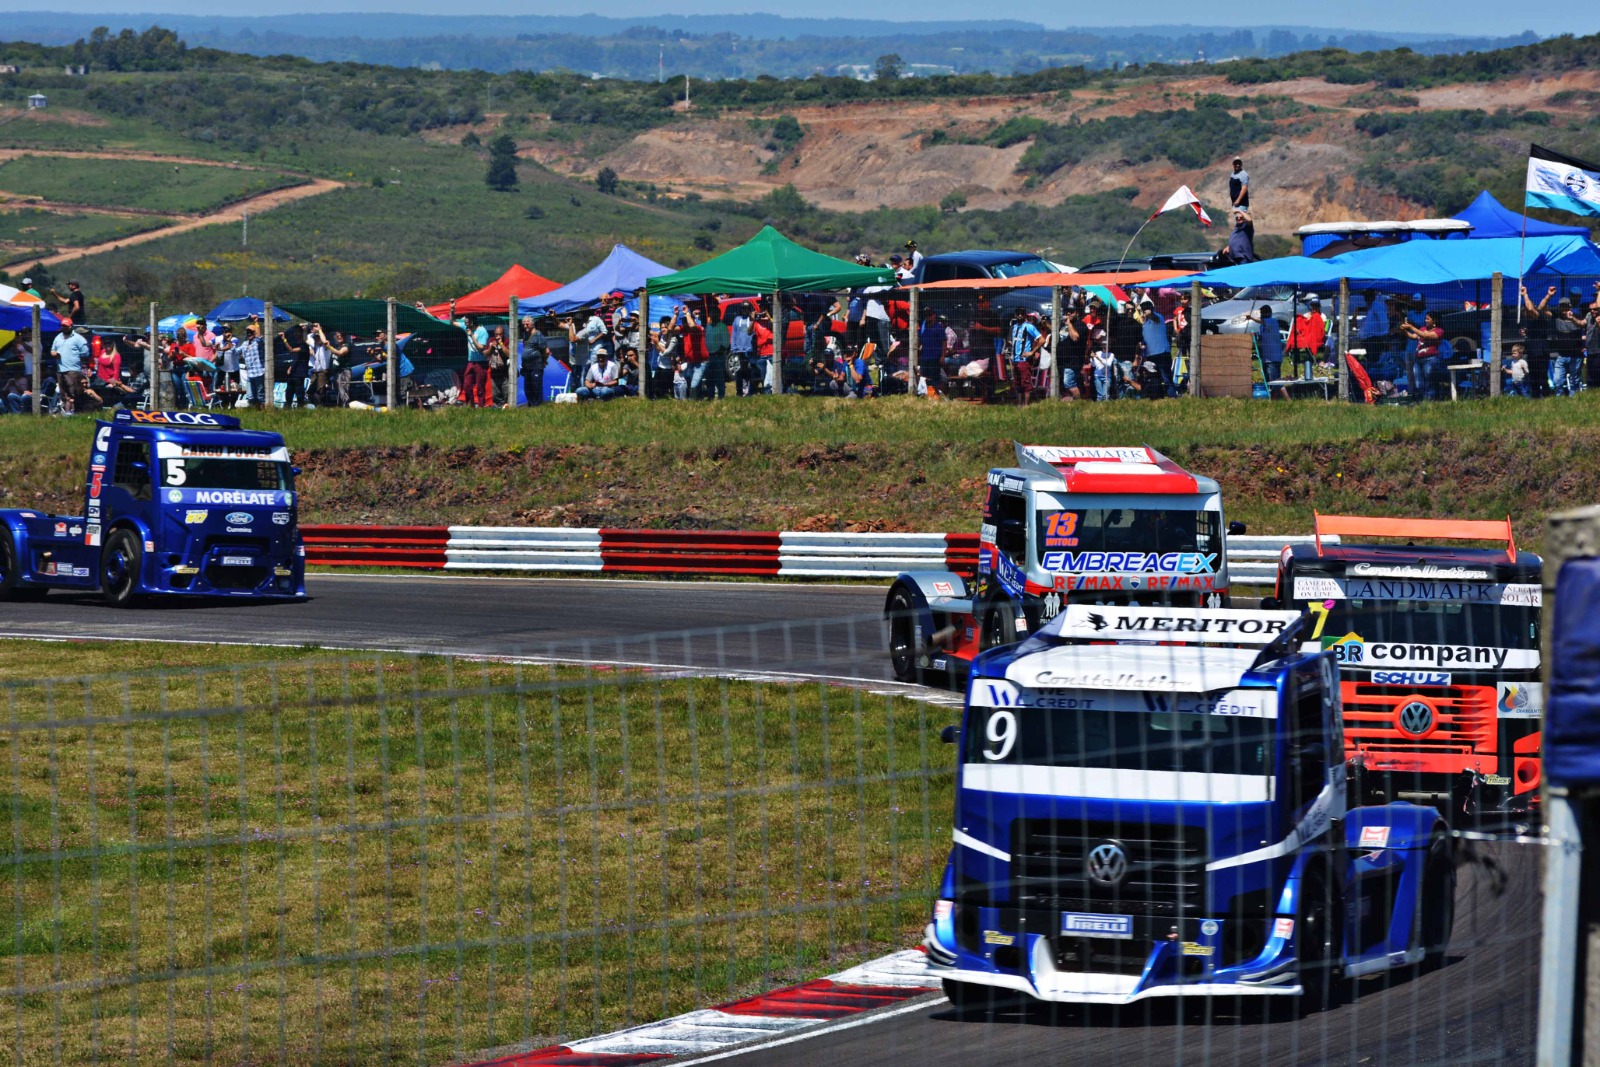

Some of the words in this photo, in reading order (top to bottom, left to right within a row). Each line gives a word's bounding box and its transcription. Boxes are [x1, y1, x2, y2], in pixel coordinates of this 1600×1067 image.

[132, 411, 218, 425] RGLOG
[181, 445, 223, 457] CARGO
[227, 447, 272, 459] POWER
[167, 460, 187, 486] 5
[90, 473, 103, 498] 5
[1047, 513, 1078, 536] 13
[1043, 553, 1218, 572] EMBREAGEX
[1354, 563, 1488, 578] Constellation
[1055, 576, 1123, 590] RE/MAX
[1147, 577, 1215, 592] RE/MAX
[1342, 580, 1495, 601] LANDMARK
[1502, 594, 1539, 604] SOLAR
[1115, 616, 1286, 634] MERITOR
[1308, 601, 1330, 640] 7
[1332, 643, 1363, 663] BR
[1371, 643, 1508, 669] company
[1374, 672, 1450, 685] SCHULZ
[1036, 697, 1094, 709] CREDIT
[1195, 703, 1257, 716] CREDIT
[983, 711, 1017, 761] 9
[1066, 917, 1128, 932] PIRELLI
